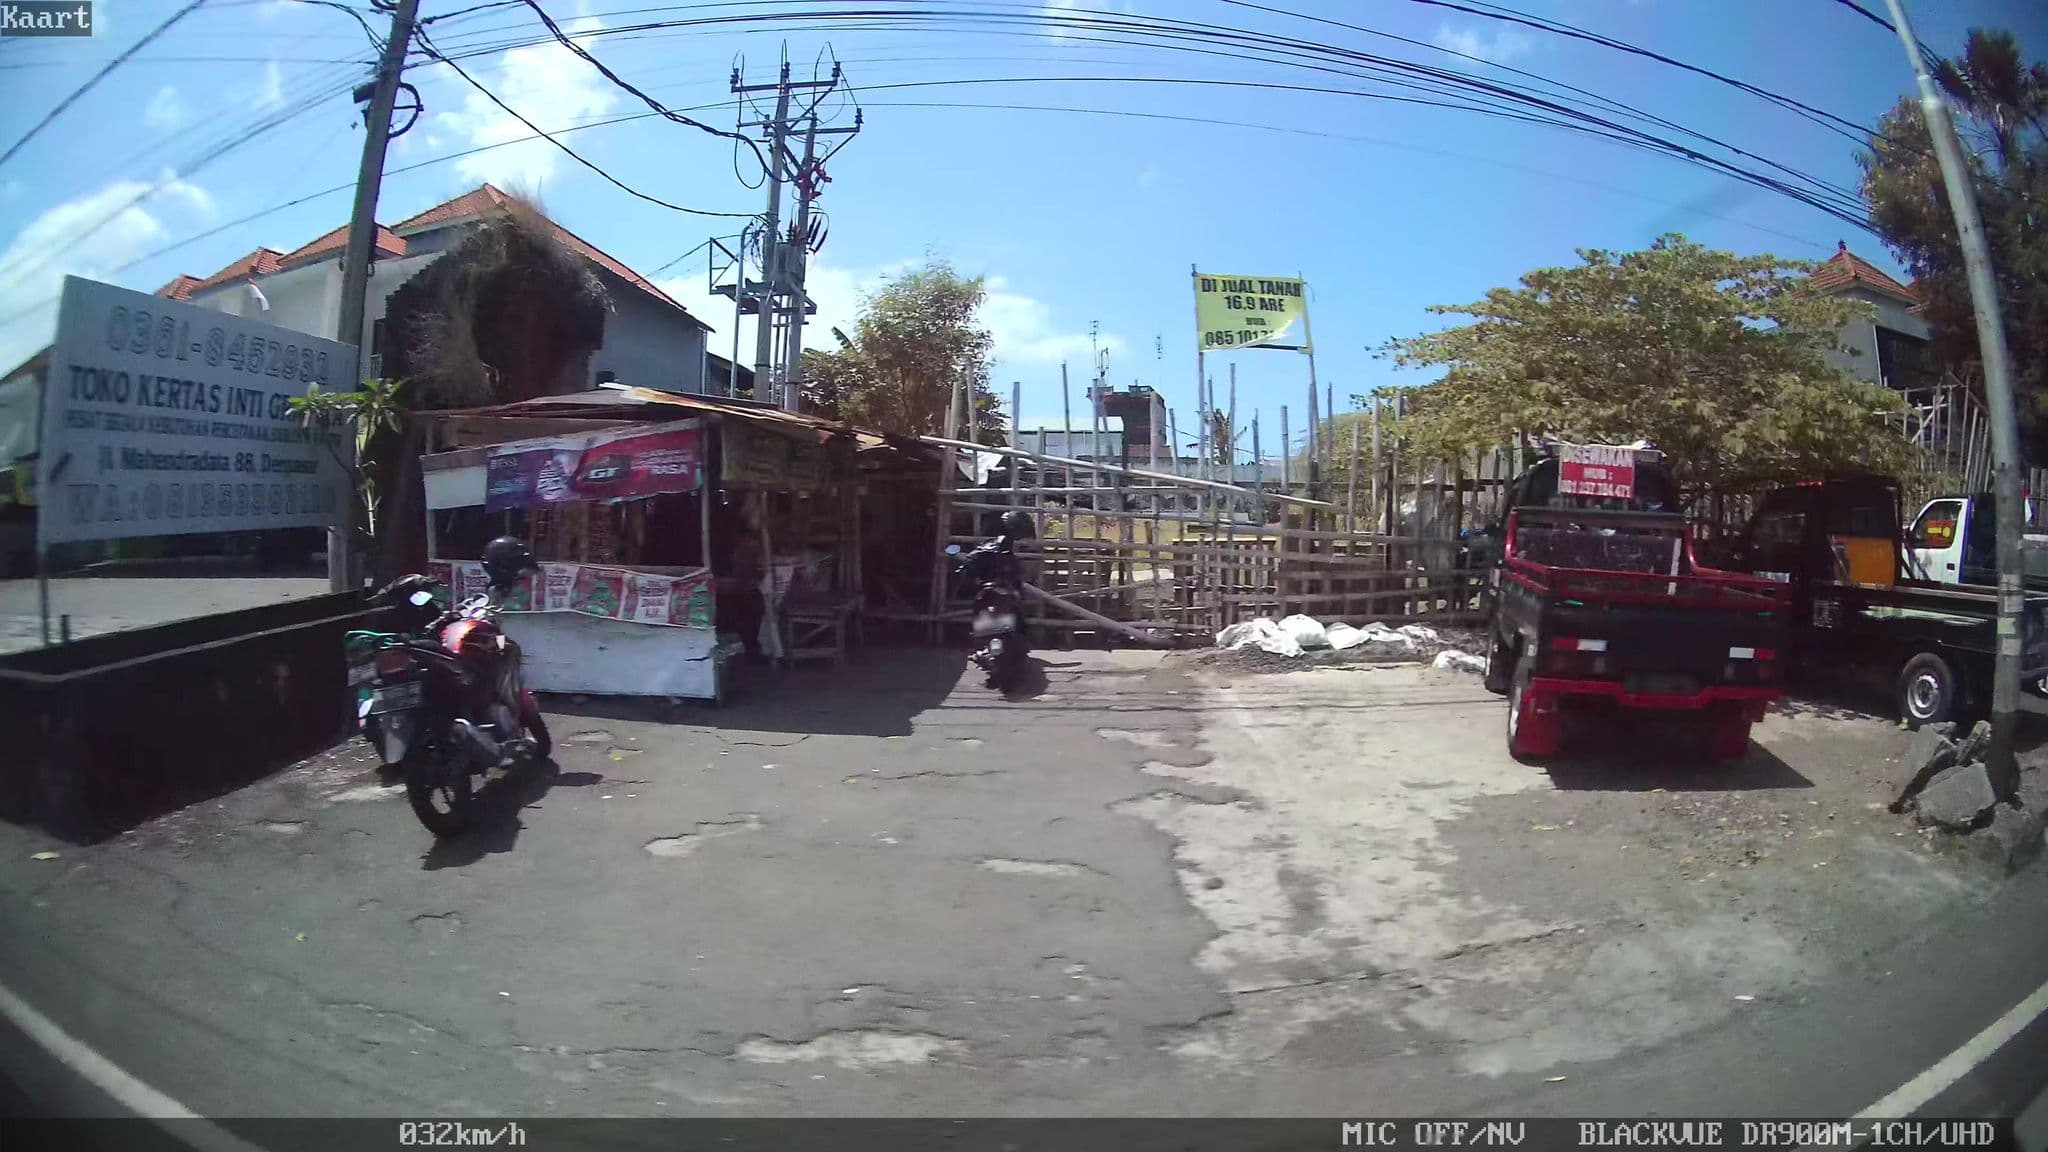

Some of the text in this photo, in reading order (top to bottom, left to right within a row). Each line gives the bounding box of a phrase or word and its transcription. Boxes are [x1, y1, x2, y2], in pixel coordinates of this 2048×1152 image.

[1200, 278, 1302, 297] DI JUAL TANAH
[1224, 295, 1285, 312] 16.9 ARE
[68, 365, 130, 404] TOKO
[136, 374, 222, 414] KERTAS
[226, 386, 264, 417] INTI
